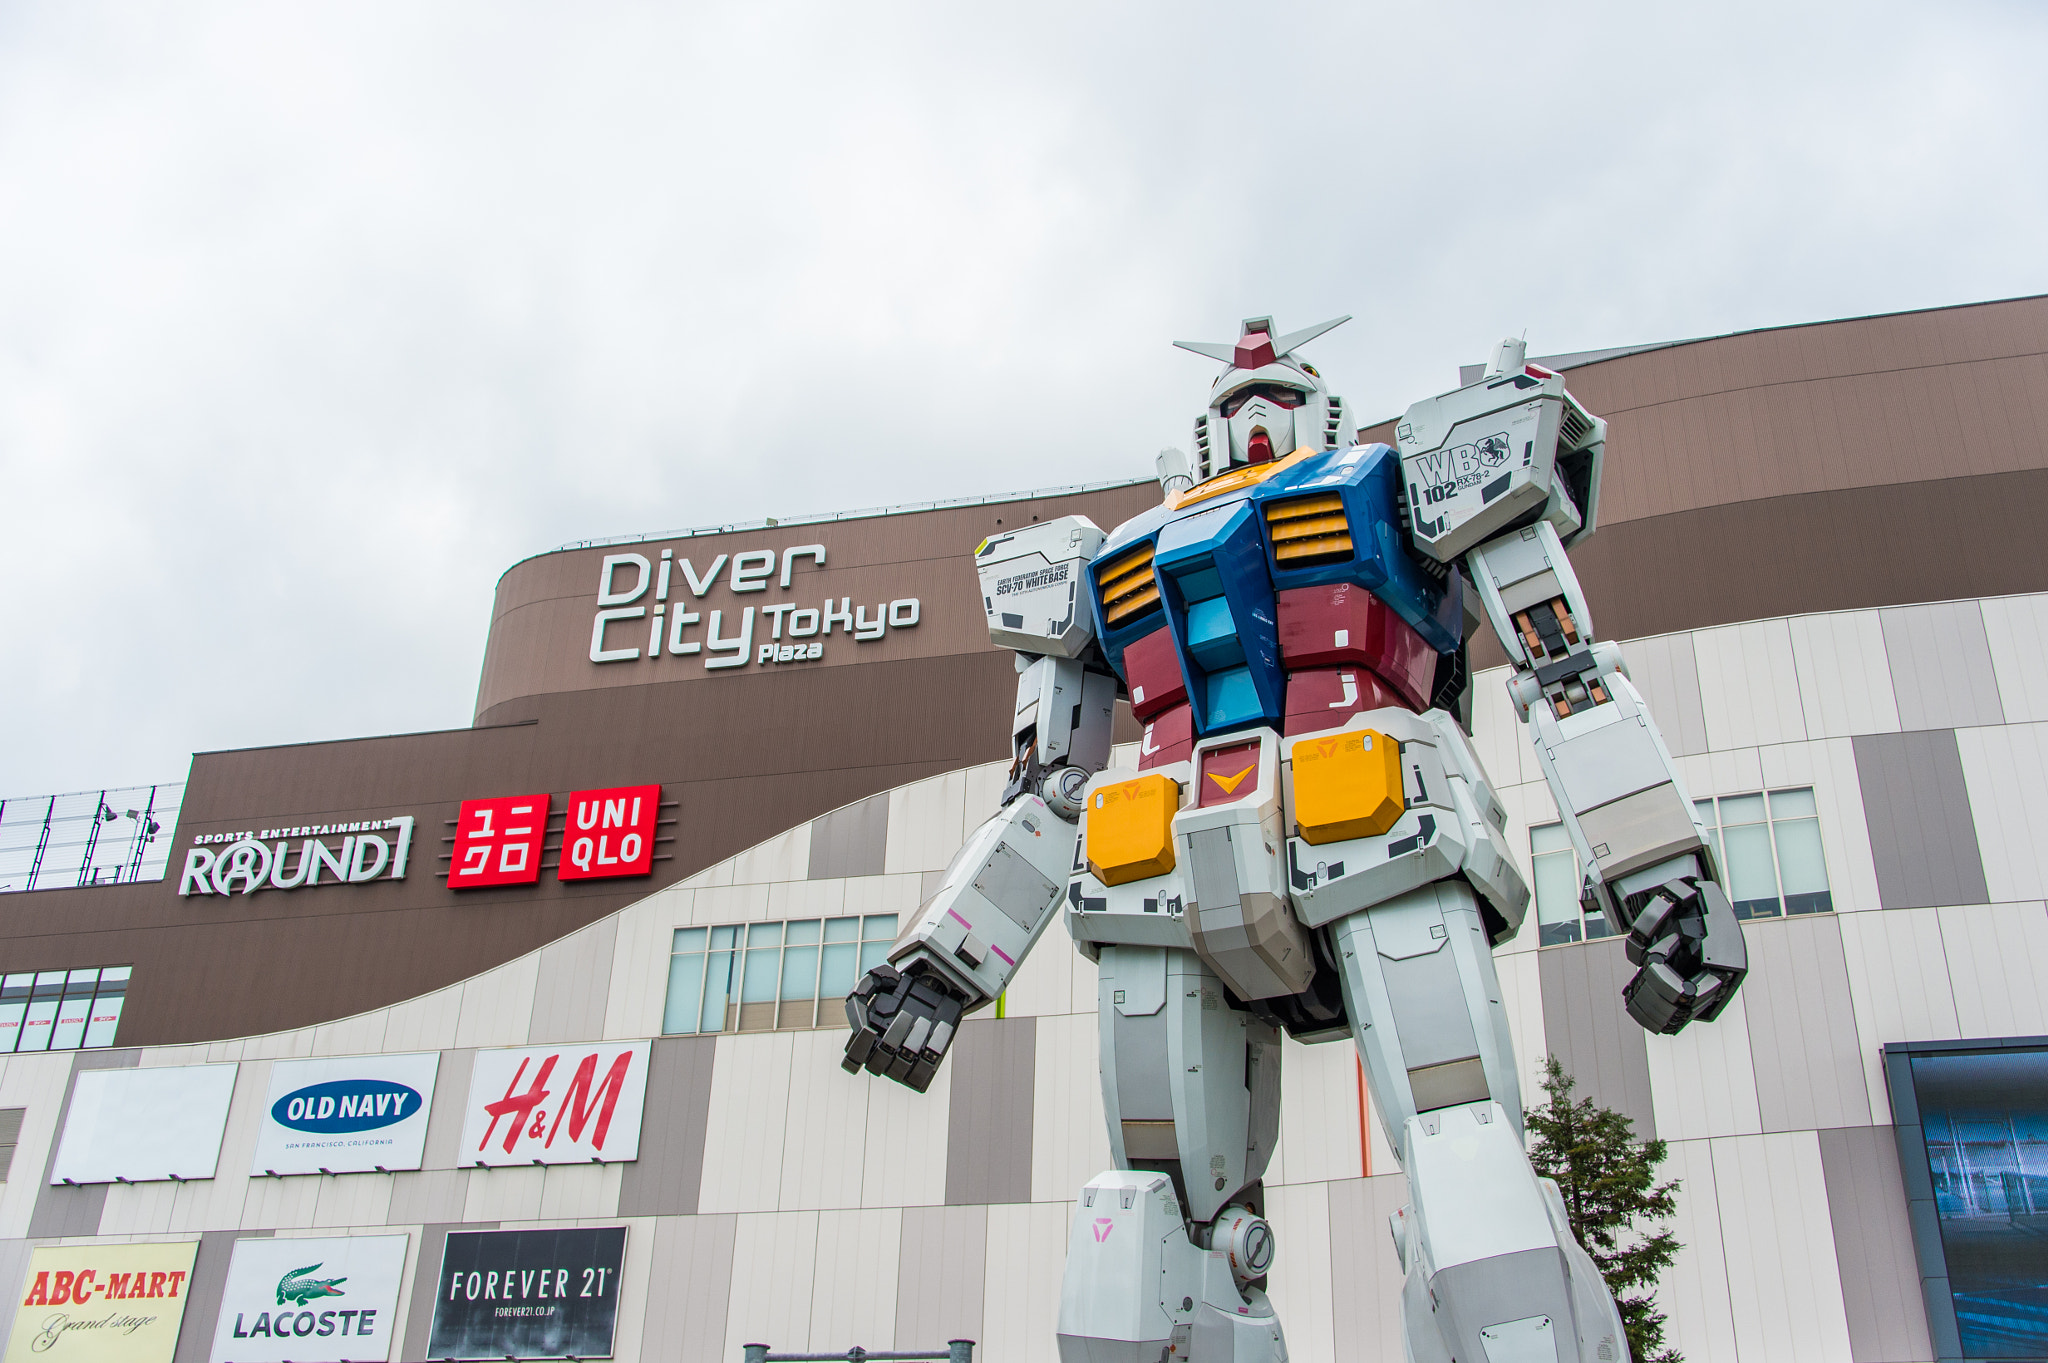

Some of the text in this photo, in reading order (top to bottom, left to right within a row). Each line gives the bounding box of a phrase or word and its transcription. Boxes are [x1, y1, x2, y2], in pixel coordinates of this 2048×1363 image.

[1416, 444, 1480, 487] WB
[1456, 470, 1490, 486] RX-78-2
[1423, 481, 1458, 505] 102
[1457, 480, 1482, 491] GUNDAM
[597, 543, 826, 608] Diver
[1040, 568, 1053, 576] SPACE
[1055, 563, 1069, 571] FORCE
[996, 581, 1023, 595] SCV-70
[589, 602, 755, 670] City
[757, 642, 823, 666] Plaza
[468, 805, 533, 839] ユニ
[576, 797, 641, 830] UNI
[194, 819, 392, 845] SPORTS ENTERTAINMENT
[459, 842, 530, 876] クロ
[571, 833, 642, 872] QLO
[287, 1092, 409, 1121] OLD NAVY
[478, 1050, 633, 1154] H&M
[302, 1140, 346, 1149] FRANCISCO,
[347, 1138, 393, 1147] CALIFORNIA
[24, 1269, 186, 1306] ABC-MART
[450, 1268, 569, 1301] FOREVER
[233, 1309, 377, 1338] LACOSTE
[494, 1306, 556, 1318] FOREVER21.CO.JP
[31, 1312, 158, 1353] Grand stage
